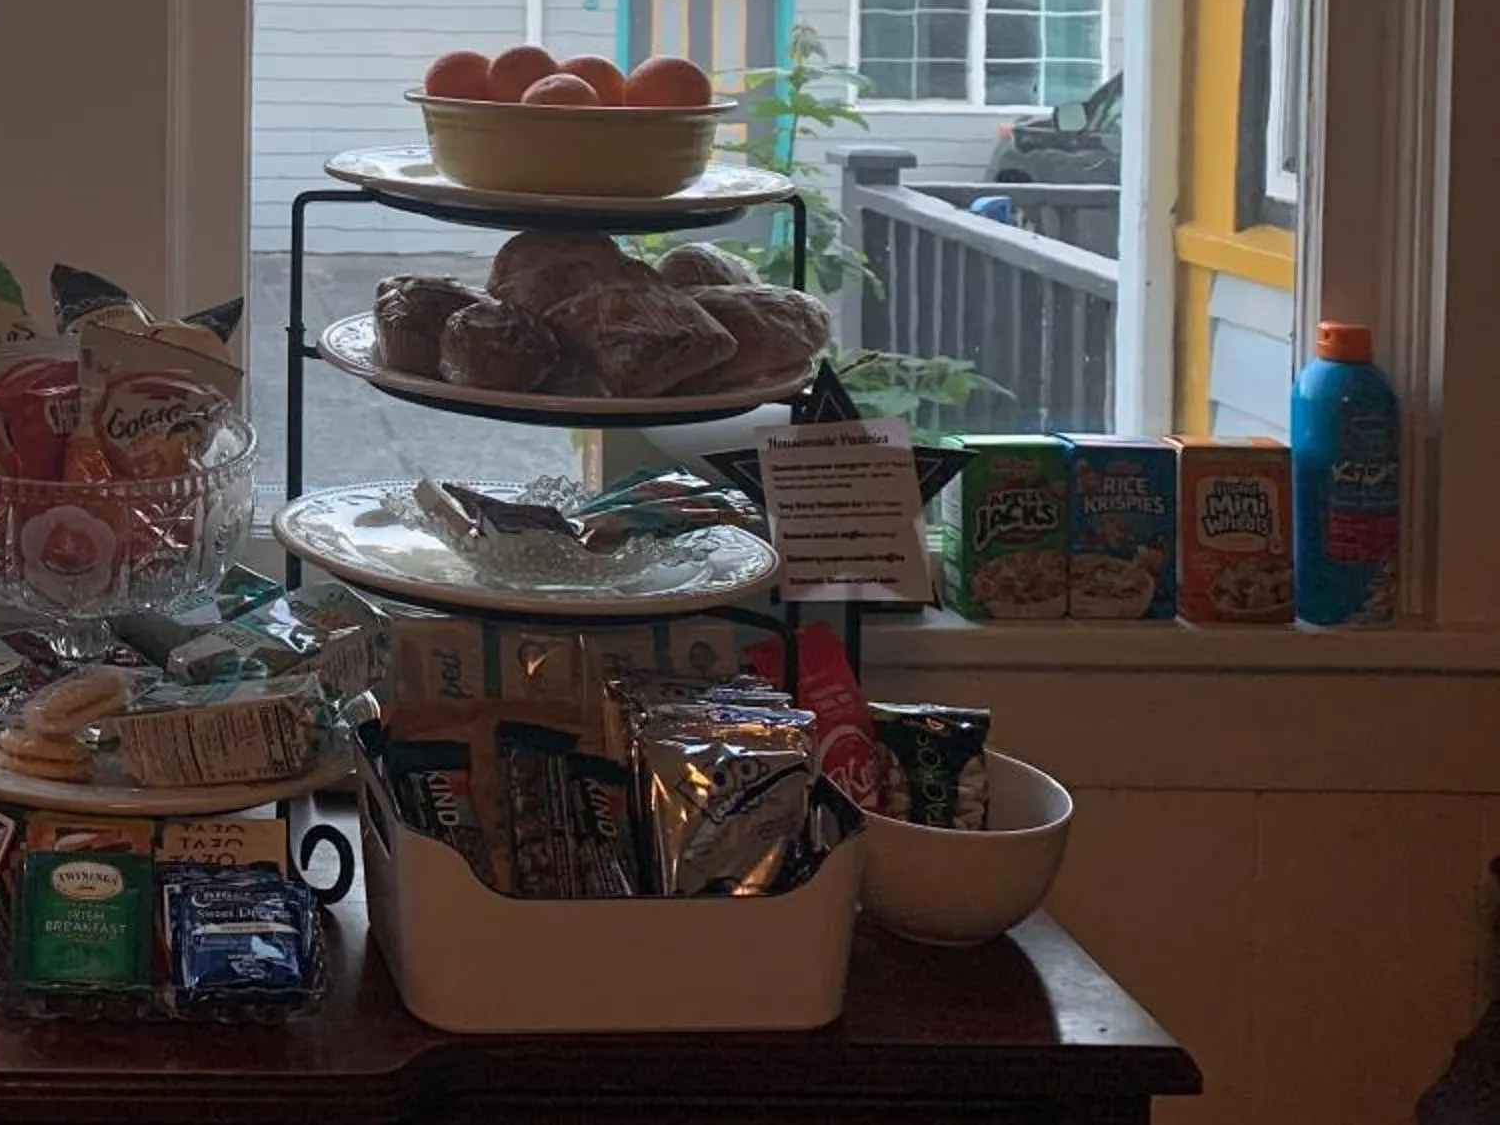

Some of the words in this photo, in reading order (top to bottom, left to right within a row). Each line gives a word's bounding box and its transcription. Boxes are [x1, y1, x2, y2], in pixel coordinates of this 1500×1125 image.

[1102, 475, 1149, 494] RICE
[1082, 493, 1165, 516] KRISPIES
[1206, 493, 1269, 517] Mini
[424, 770, 460, 826] KIND
[584, 778, 618, 837] KIND
[44, 920, 128, 936] BREAKFAST
